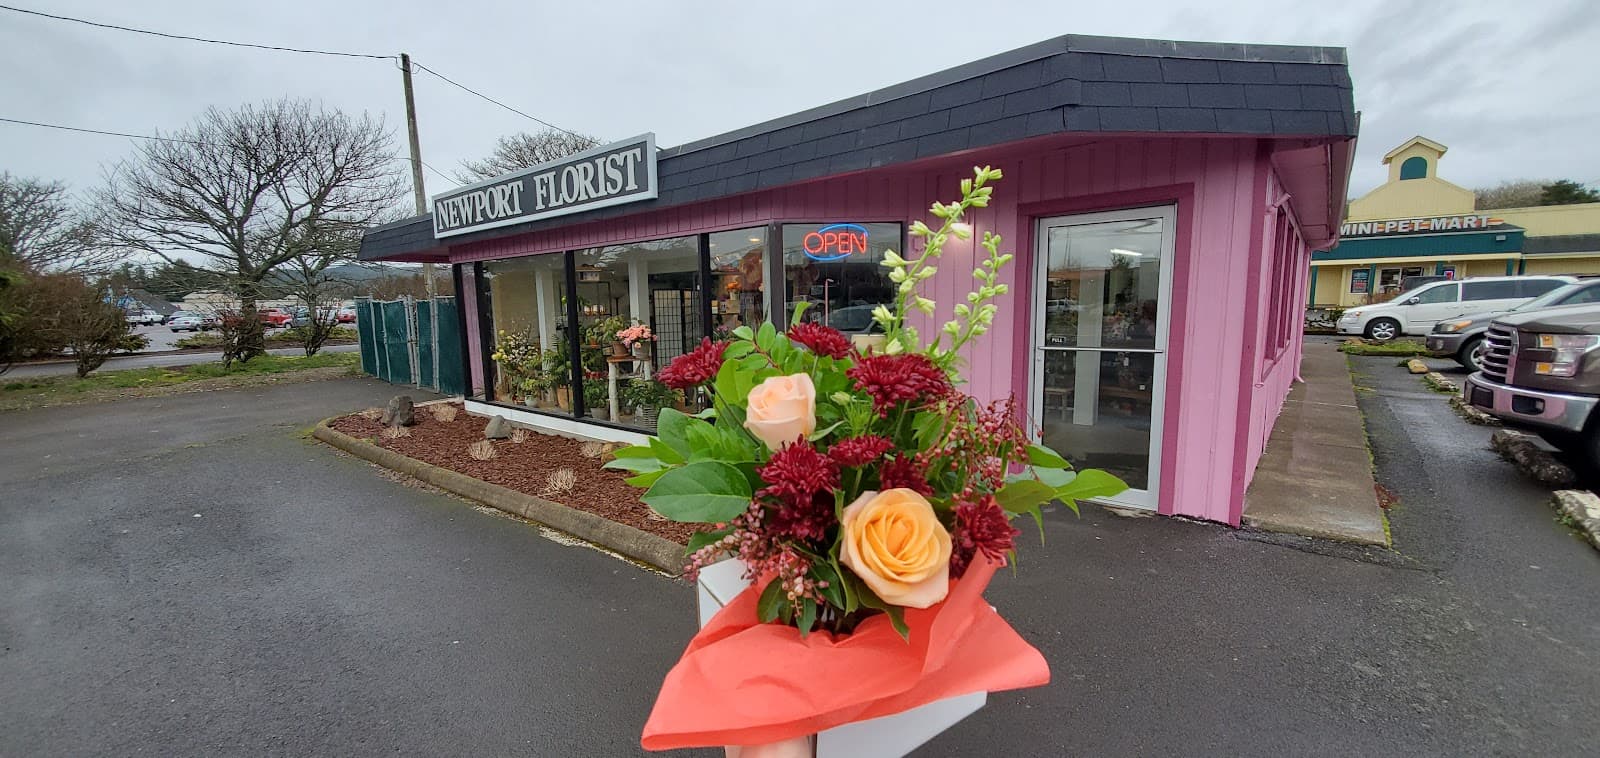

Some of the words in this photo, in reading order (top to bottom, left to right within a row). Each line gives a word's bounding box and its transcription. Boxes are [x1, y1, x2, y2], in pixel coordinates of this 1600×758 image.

[437, 180, 524, 230] NEWPORT
[533, 147, 642, 211] FLORIST
[1384, 219, 1423, 233] PET
[1430, 215, 1491, 231] MART
[803, 231, 867, 254] OPEN
